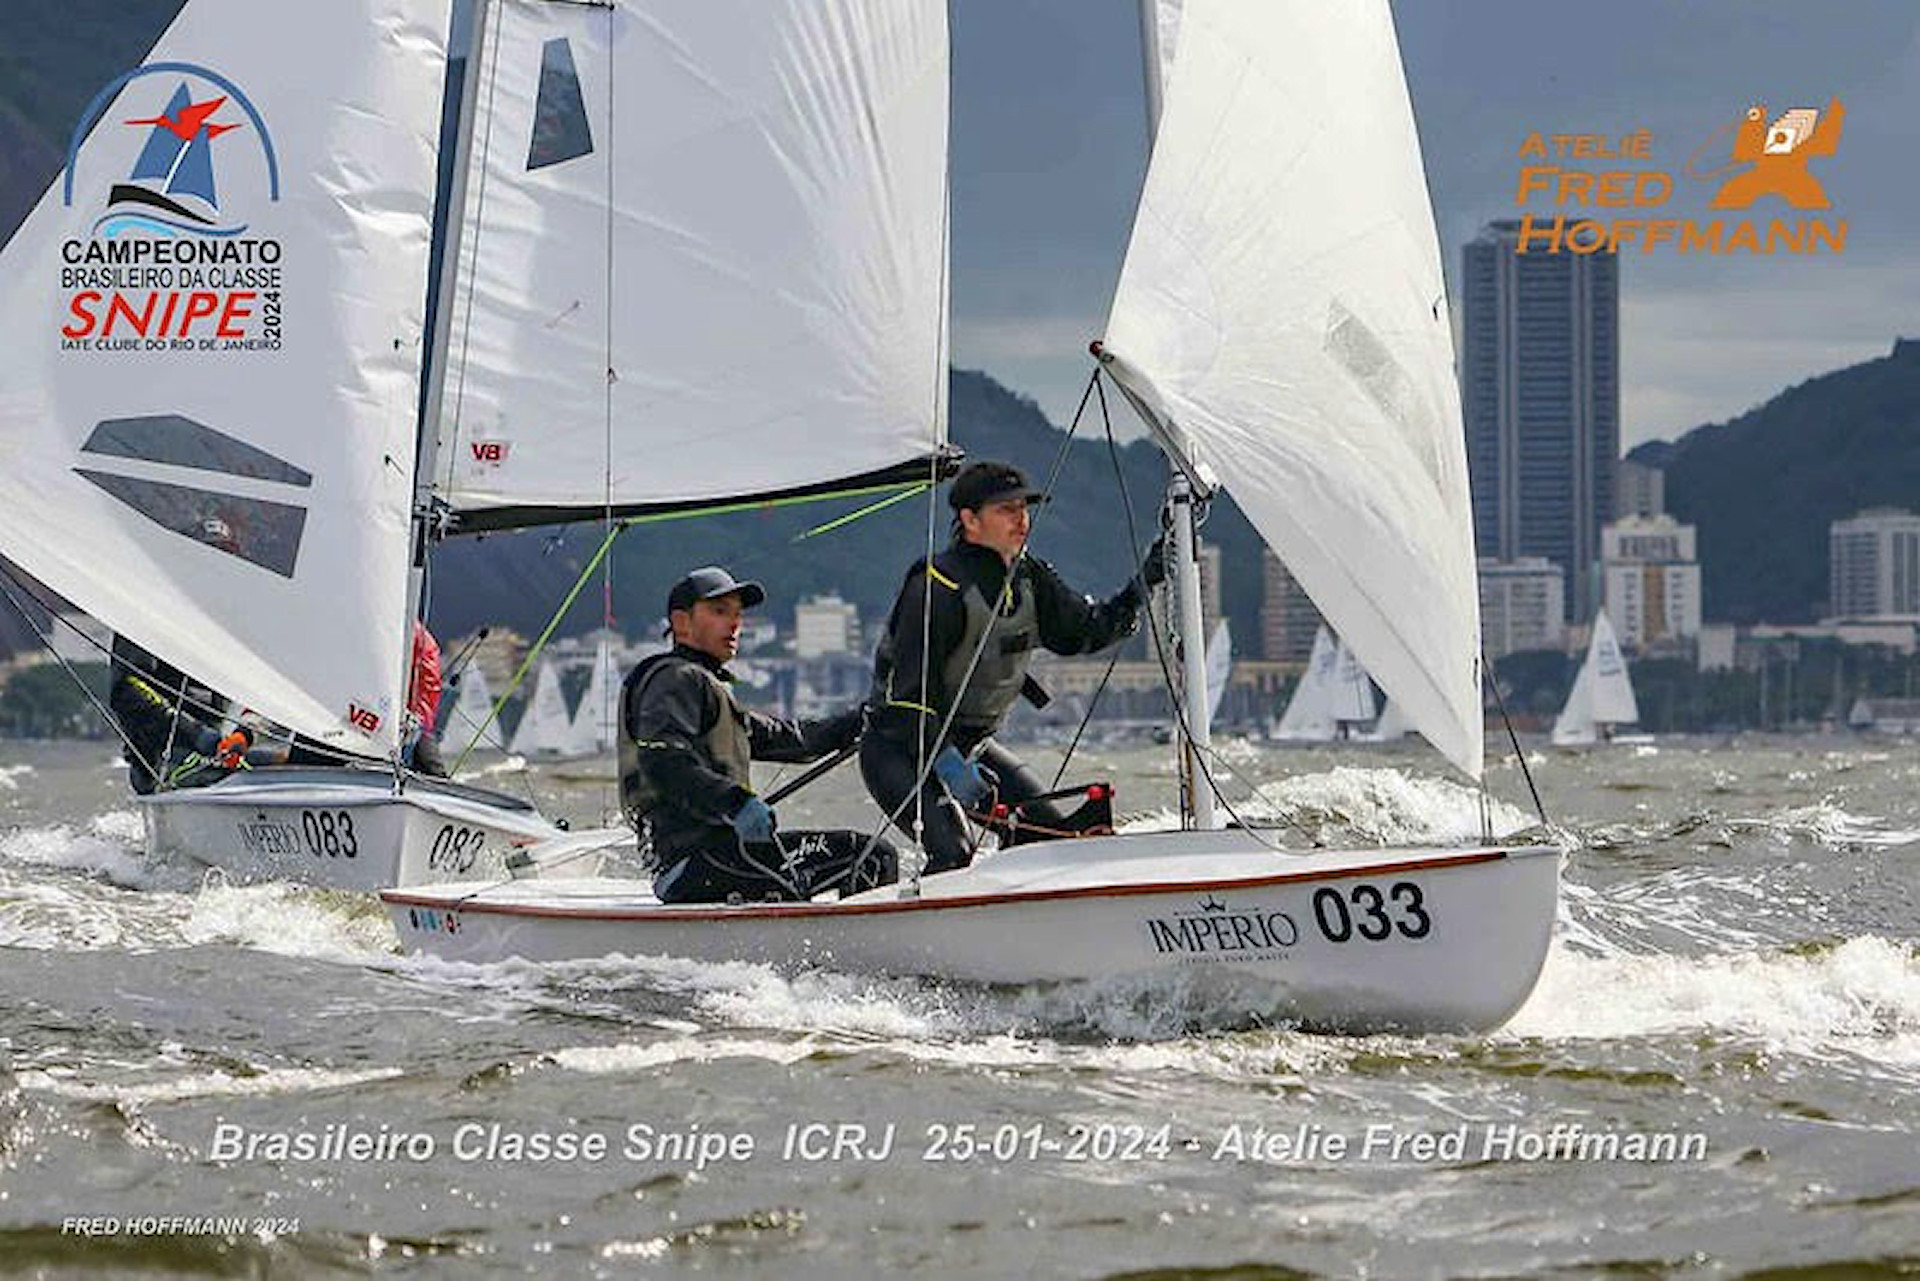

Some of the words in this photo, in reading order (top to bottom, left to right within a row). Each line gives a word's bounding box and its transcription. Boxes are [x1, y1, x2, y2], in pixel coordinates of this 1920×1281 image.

[302, 810, 357, 859] 083
[428, 824, 485, 875] 083
[1312, 881, 1431, 944] 033
